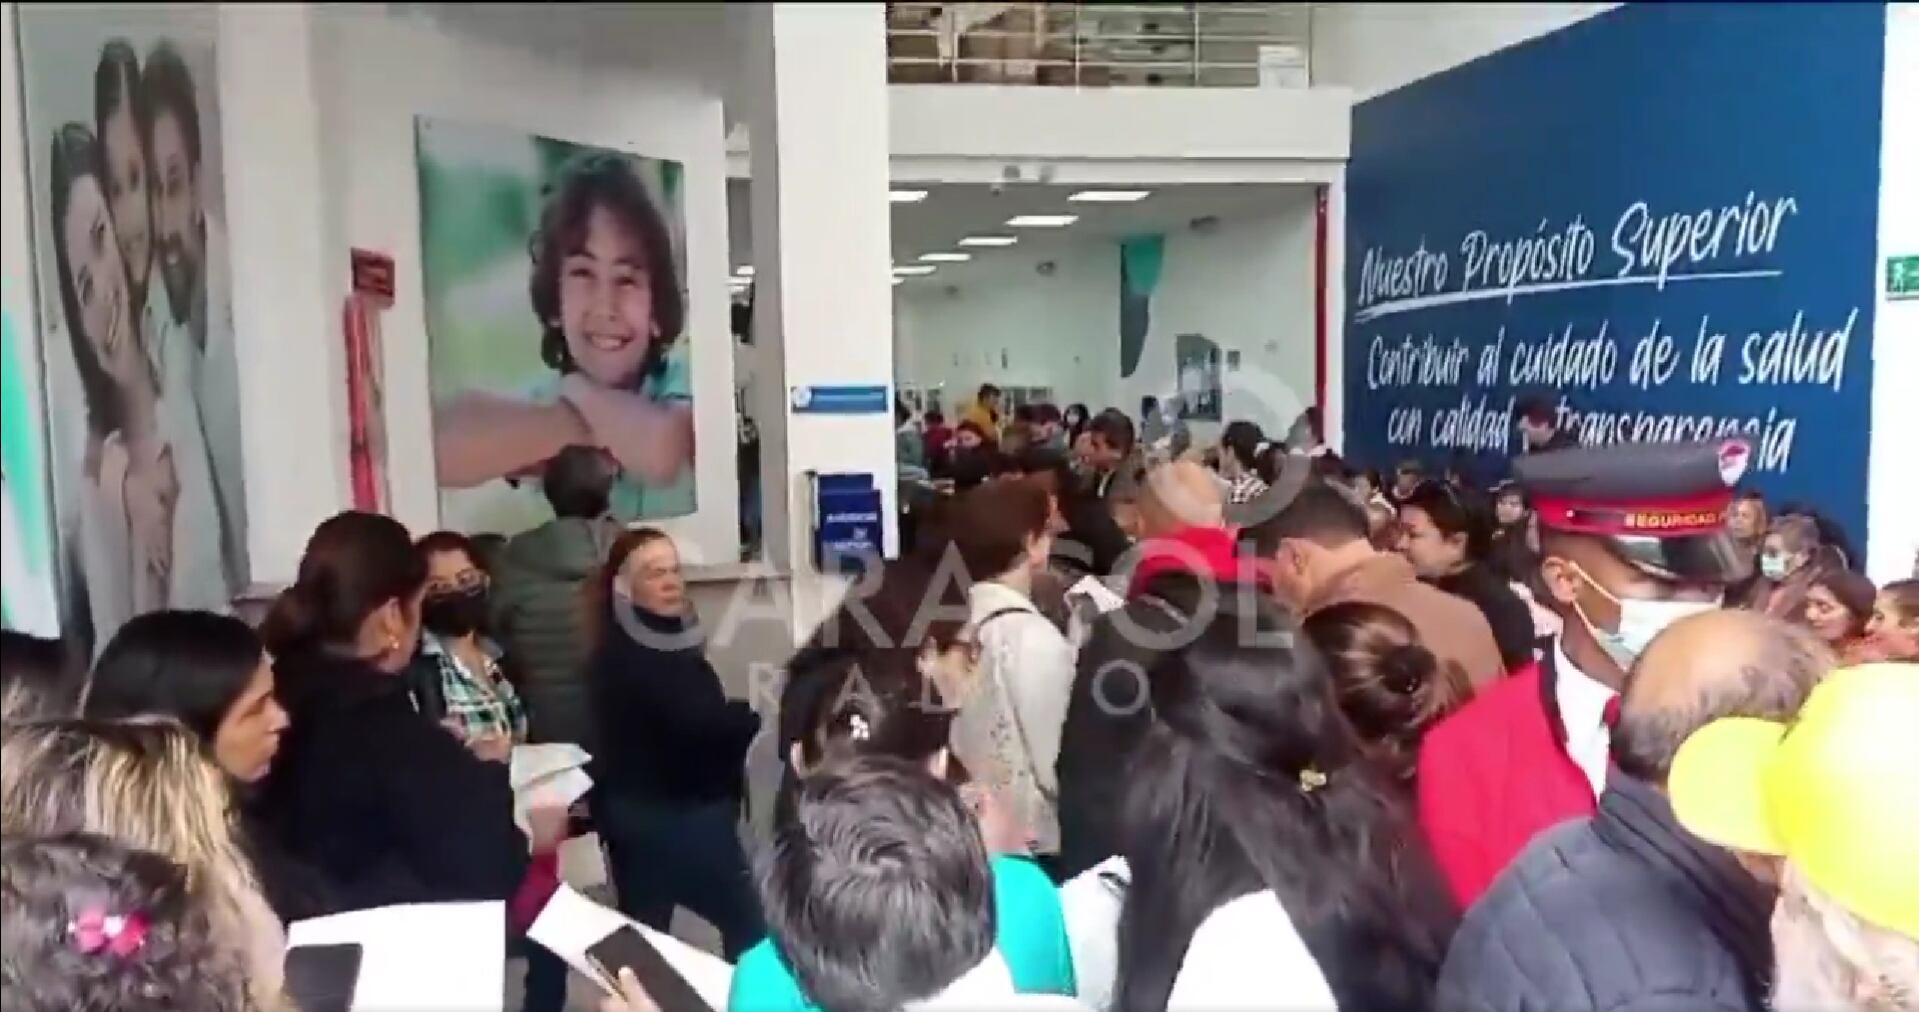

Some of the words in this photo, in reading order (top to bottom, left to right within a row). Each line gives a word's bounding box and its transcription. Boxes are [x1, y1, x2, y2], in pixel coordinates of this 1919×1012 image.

[1358, 233, 1449, 306] Nuestro
[1461, 212, 1595, 306] Propósito
[1611, 190, 1798, 291] Superior
[1367, 332, 1469, 390] Contribuir
[1477, 324, 1505, 387] al
[1510, 319, 1618, 391] cuidado
[1629, 318, 1681, 391] de
[1691, 314, 1727, 386] la
[1738, 306, 1858, 392] salud
[1387, 407, 1422, 446] con
[1430, 392, 1516, 455] calidad
